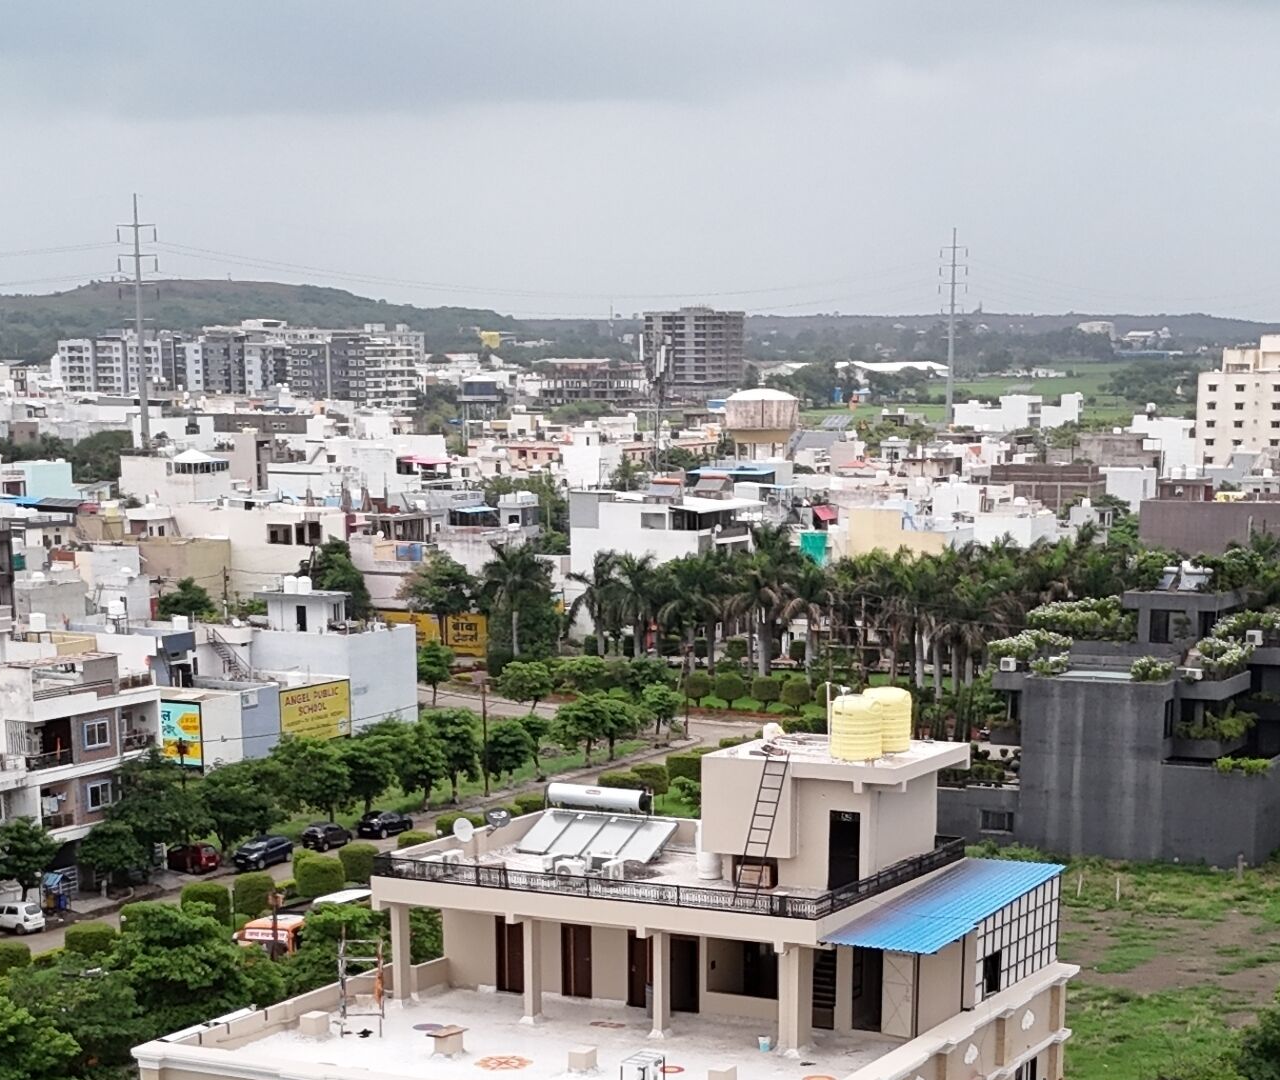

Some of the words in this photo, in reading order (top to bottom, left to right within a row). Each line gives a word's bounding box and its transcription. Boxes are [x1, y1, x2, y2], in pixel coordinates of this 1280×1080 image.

[285, 693, 310, 706] ANGEL
[313, 686, 339, 699] PUBLIC
[298, 702, 327, 716] SCHOOL
